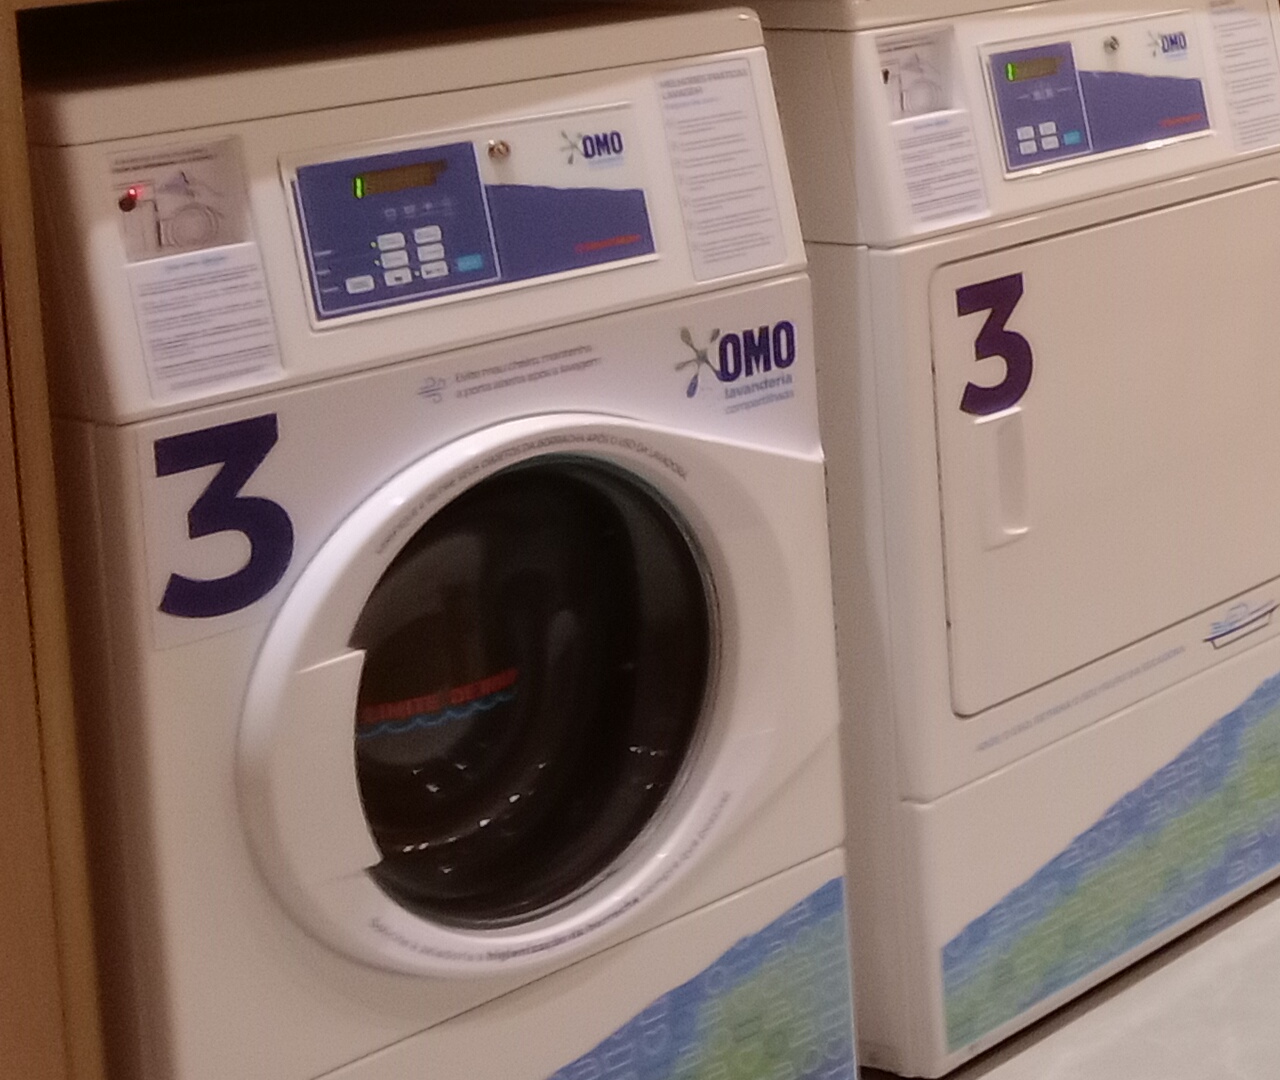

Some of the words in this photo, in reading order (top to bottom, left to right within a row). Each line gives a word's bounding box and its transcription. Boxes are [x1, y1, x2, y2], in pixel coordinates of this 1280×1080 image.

[582, 130, 623, 159] OMO
[717, 320, 796, 383] OMO
[954, 272, 1034, 416] 3
[725, 373, 793, 399] lavanderia
[154, 413, 296, 620] 3
